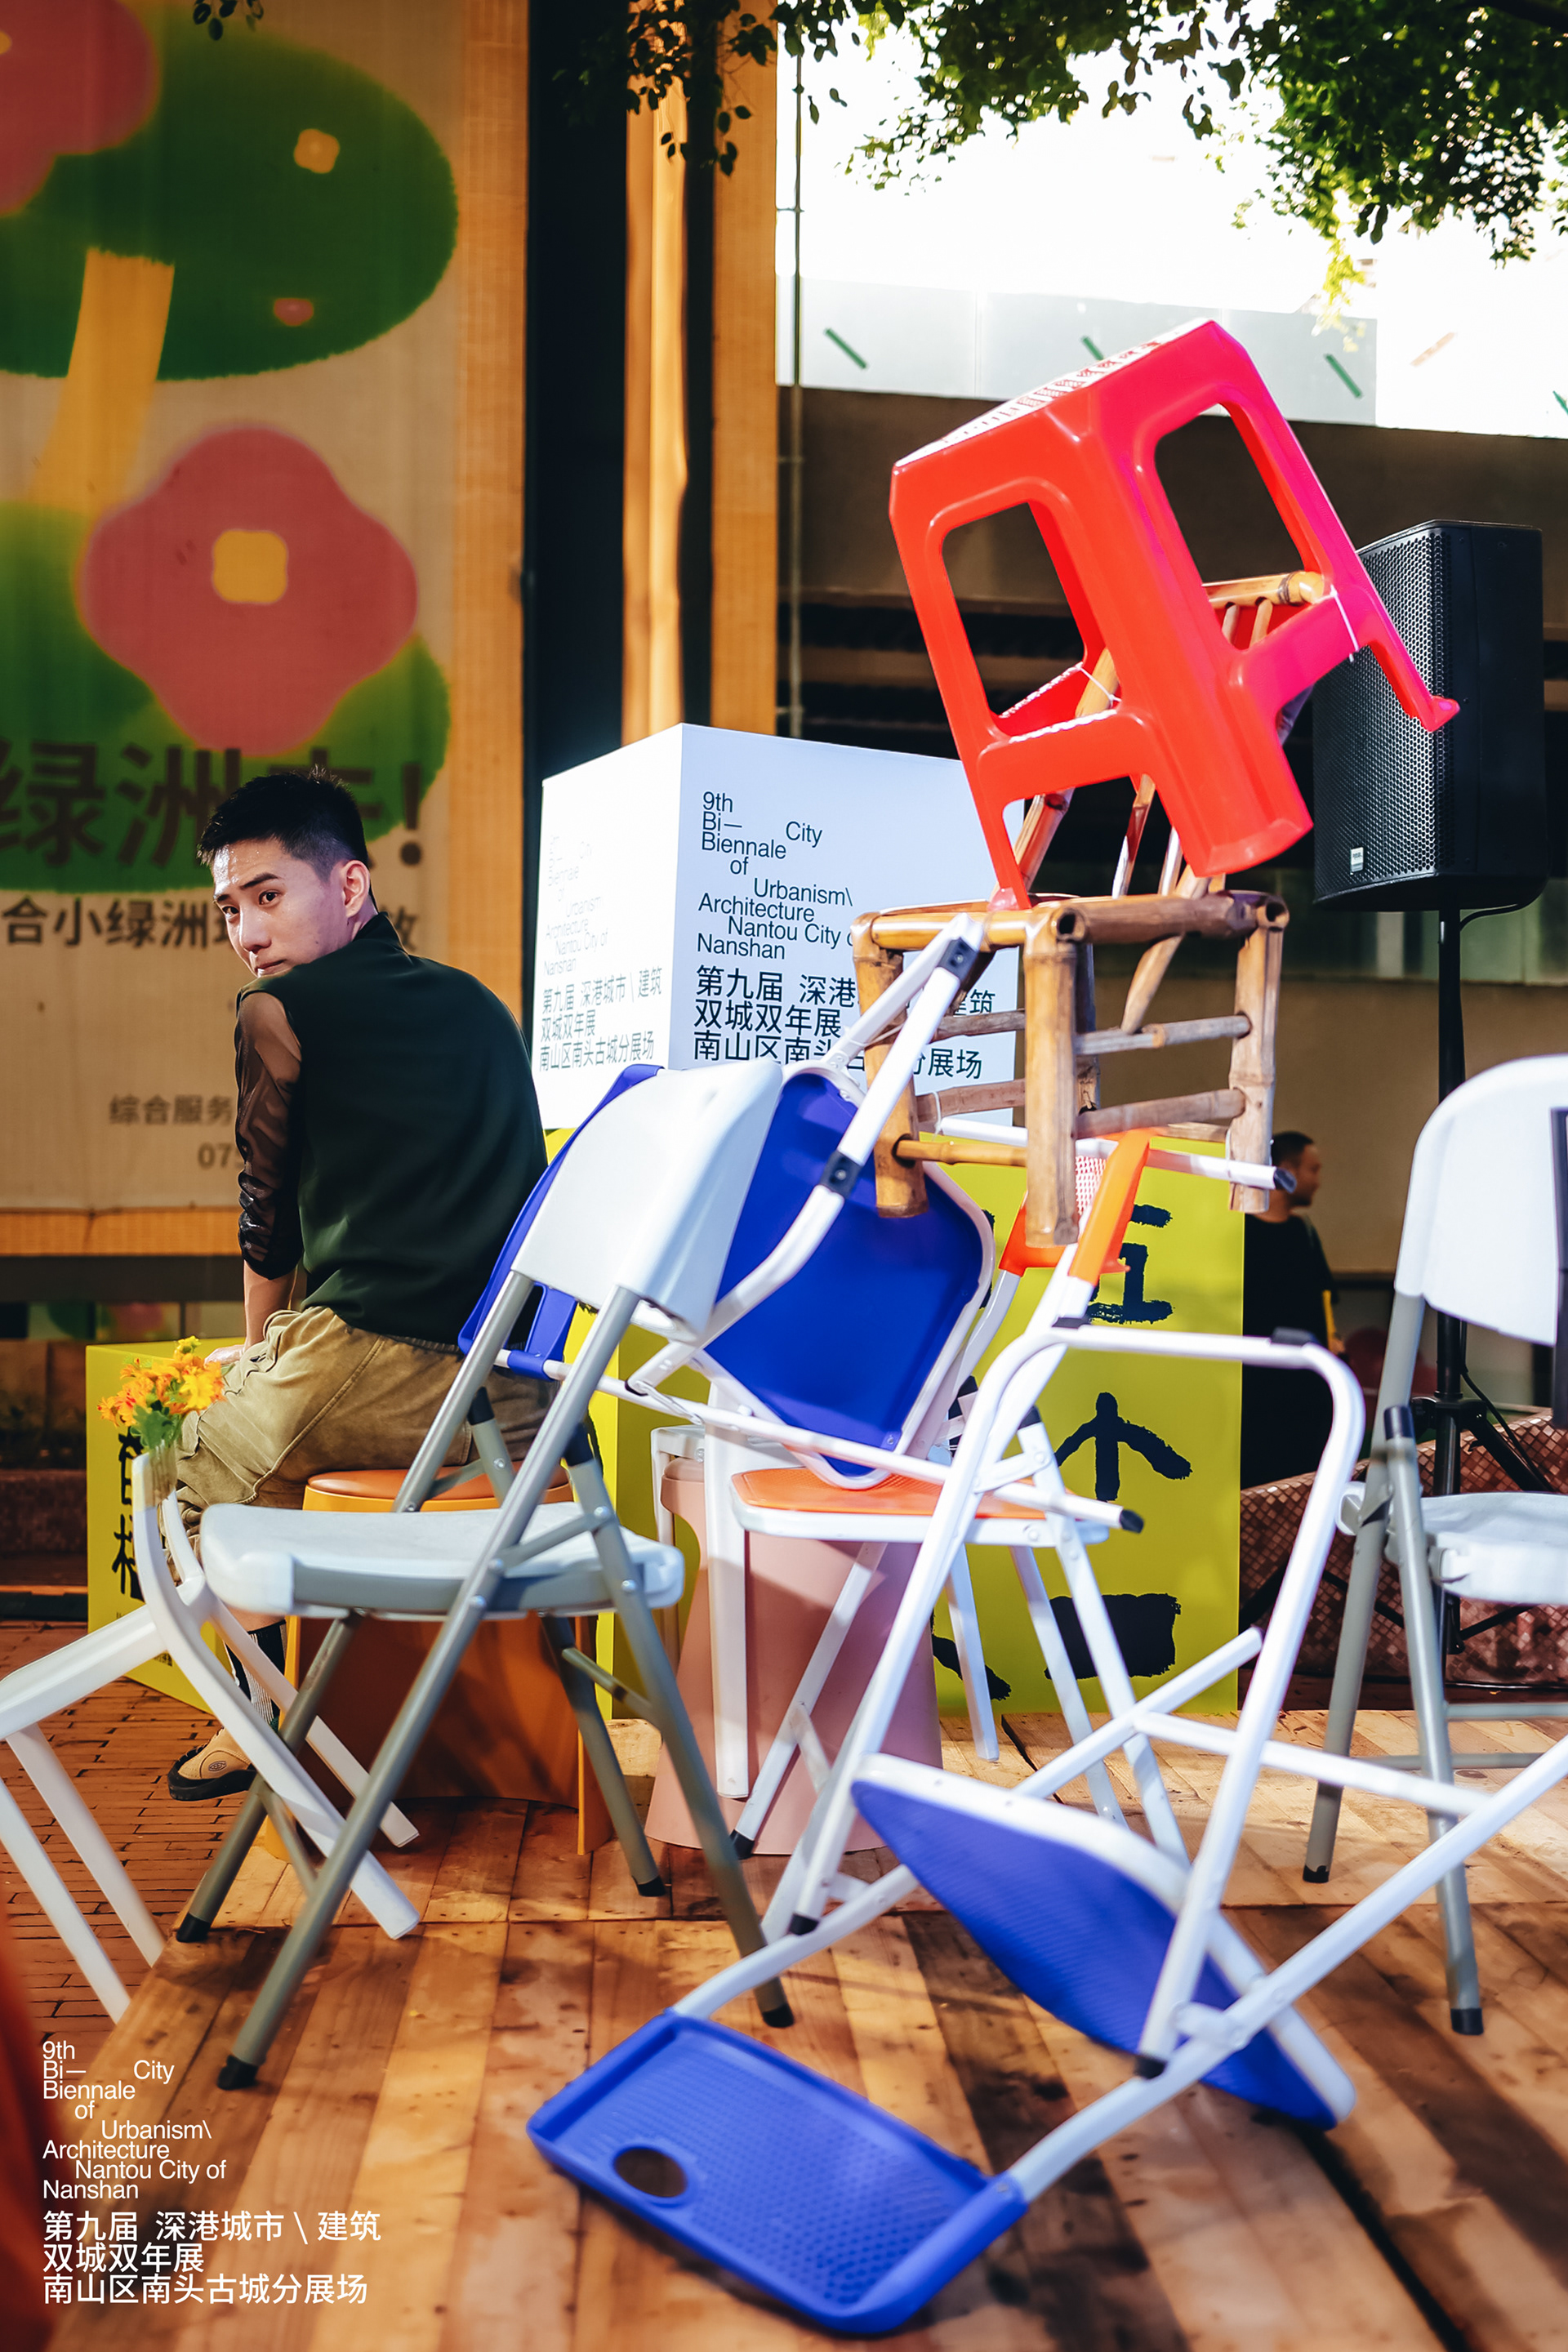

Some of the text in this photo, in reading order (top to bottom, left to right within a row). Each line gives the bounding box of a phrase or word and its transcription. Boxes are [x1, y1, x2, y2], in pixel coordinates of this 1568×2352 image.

[702, 791, 733, 813] 9th
[702, 831, 786, 859] Biennale
[786, 821, 823, 849] City
[729, 857, 749, 875] of
[697, 892, 815, 923] Architecture
[697, 933, 786, 960] Nanshan
[728, 915, 798, 941] Nantou
[804, 923, 841, 950] City
[696, 964, 783, 1003] 第九届
[540, 1009, 596, 1044] 双城双年展
[693, 998, 842, 1039] 双城双年展
[539, 1030, 655, 1073] 南山区南头古城分展场
